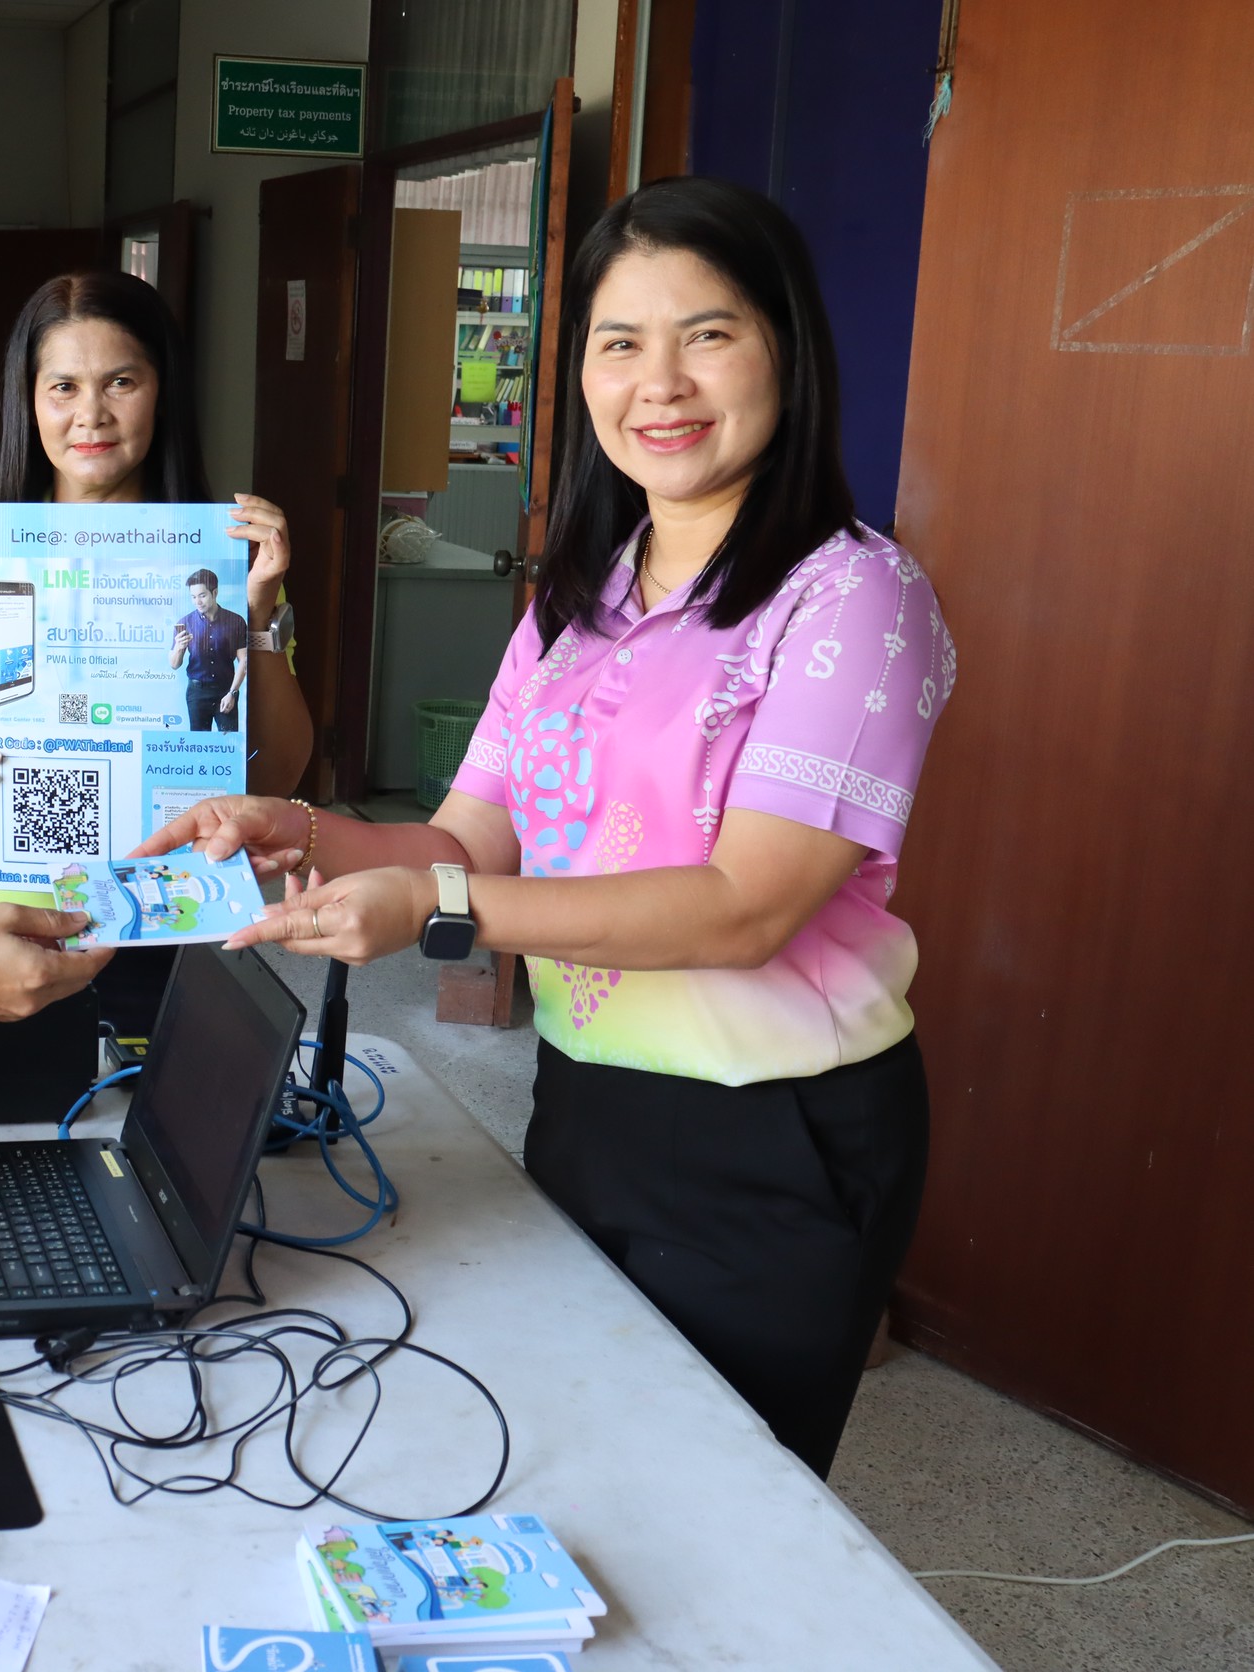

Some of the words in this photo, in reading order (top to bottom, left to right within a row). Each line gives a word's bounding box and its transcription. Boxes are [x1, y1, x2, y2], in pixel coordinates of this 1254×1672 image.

[228, 105, 274, 119] Property
[278, 108, 295, 118] tax
[299, 109, 352, 121] payments
[11, 528, 67, 546] Line@:
[74, 528, 202, 547] @pwathailand
[43, 570, 90, 589] LINE
[93, 572, 182, 590] แจ้งเตือนให้ฟรี
[46, 655, 67, 664] PWA
[68, 655, 87, 664] Line
[89, 655, 118, 665] Official
[5, 737, 36, 750] Code
[43, 738, 134, 753] @PWAThailand
[146, 737, 235, 753] รองรับทั้งสองระบบ
[146, 764, 194, 775] Android
[198, 765, 207, 775] &
[212, 765, 232, 776] IOS
